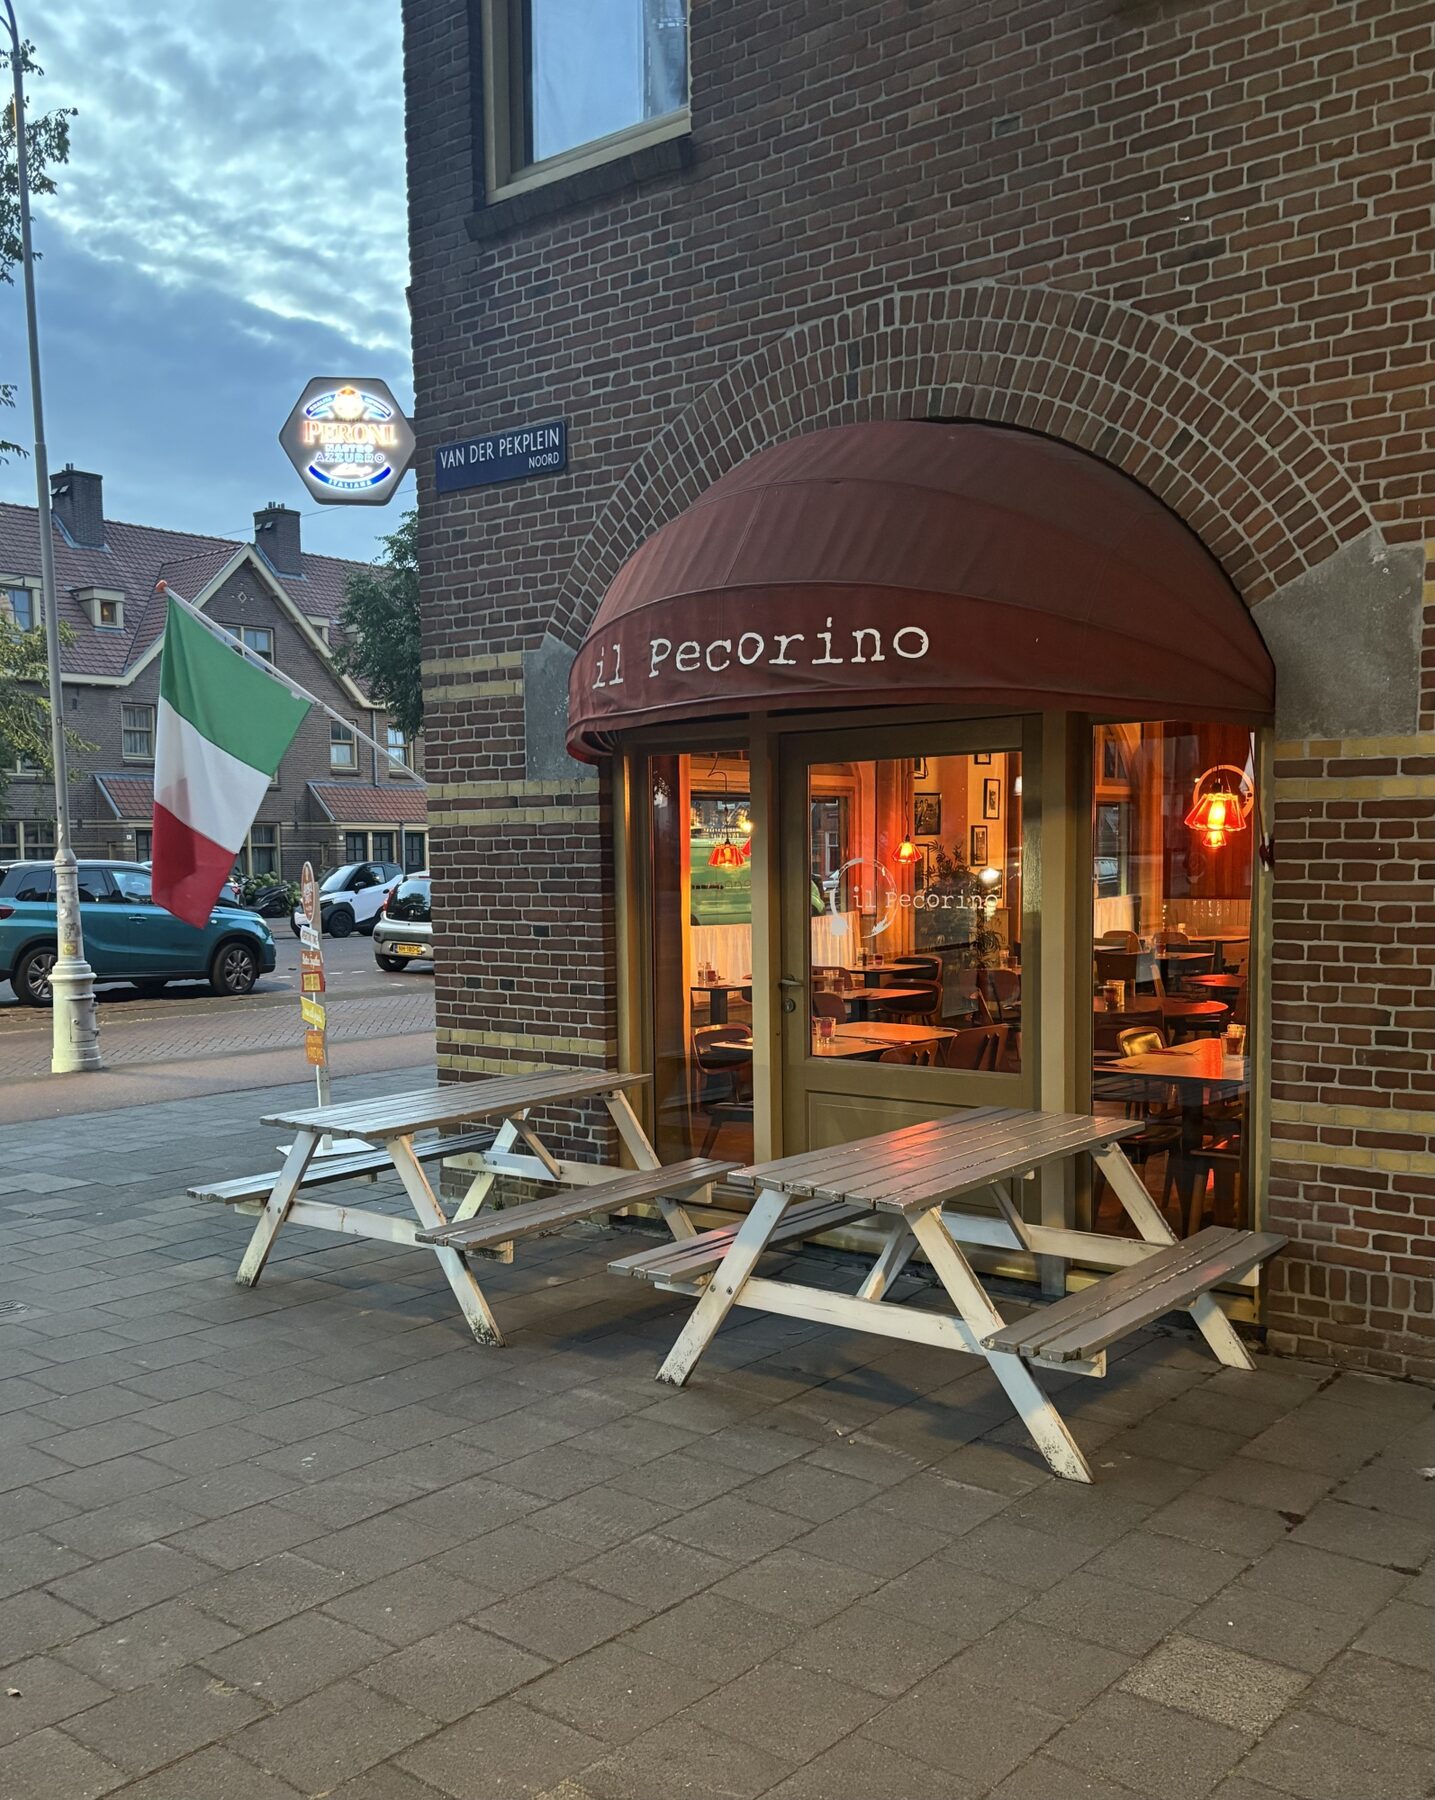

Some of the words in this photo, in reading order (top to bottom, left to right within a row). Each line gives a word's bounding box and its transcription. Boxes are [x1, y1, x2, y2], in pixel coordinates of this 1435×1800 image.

[303, 420, 397, 445] PERONI
[314, 452, 385, 463] AZZURRO
[440, 447, 465, 469] VAN
[470, 441, 495, 464] DER
[499, 427, 559, 457] PEKPLEIN
[528, 452, 560, 469] NOORD
[592, 644, 624, 690] il
[648, 616, 930, 678] Pecorino
[853, 885, 876, 909] il
[885, 890, 999, 910] Pecorino
